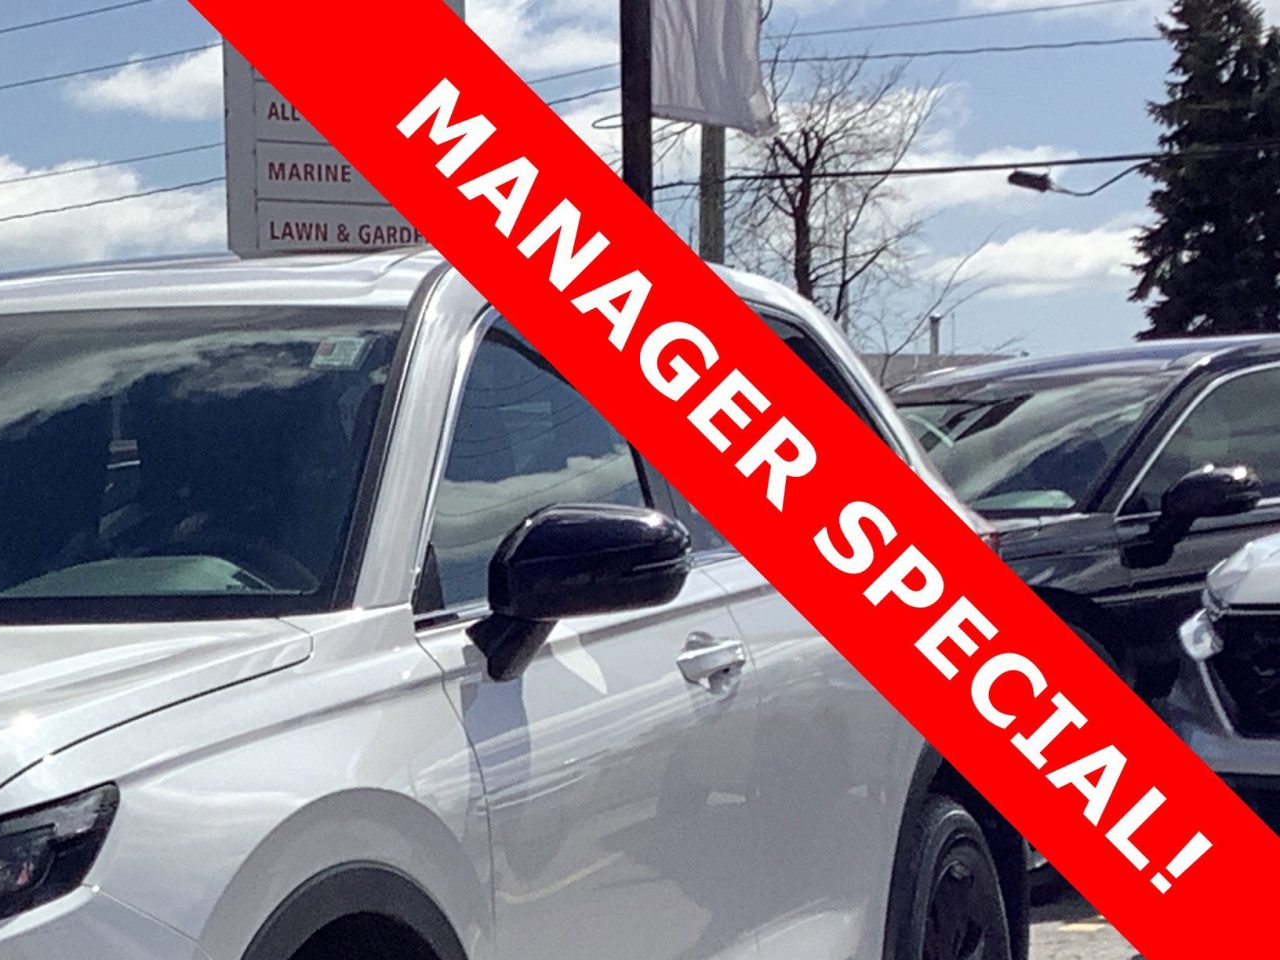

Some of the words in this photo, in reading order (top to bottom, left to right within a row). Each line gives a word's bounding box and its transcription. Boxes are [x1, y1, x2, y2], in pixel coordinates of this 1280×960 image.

[268, 161, 352, 183] MARINE
[269, 220, 328, 242] LAWN
[336, 223, 350, 243] &
[358, 223, 430, 244] GARD
